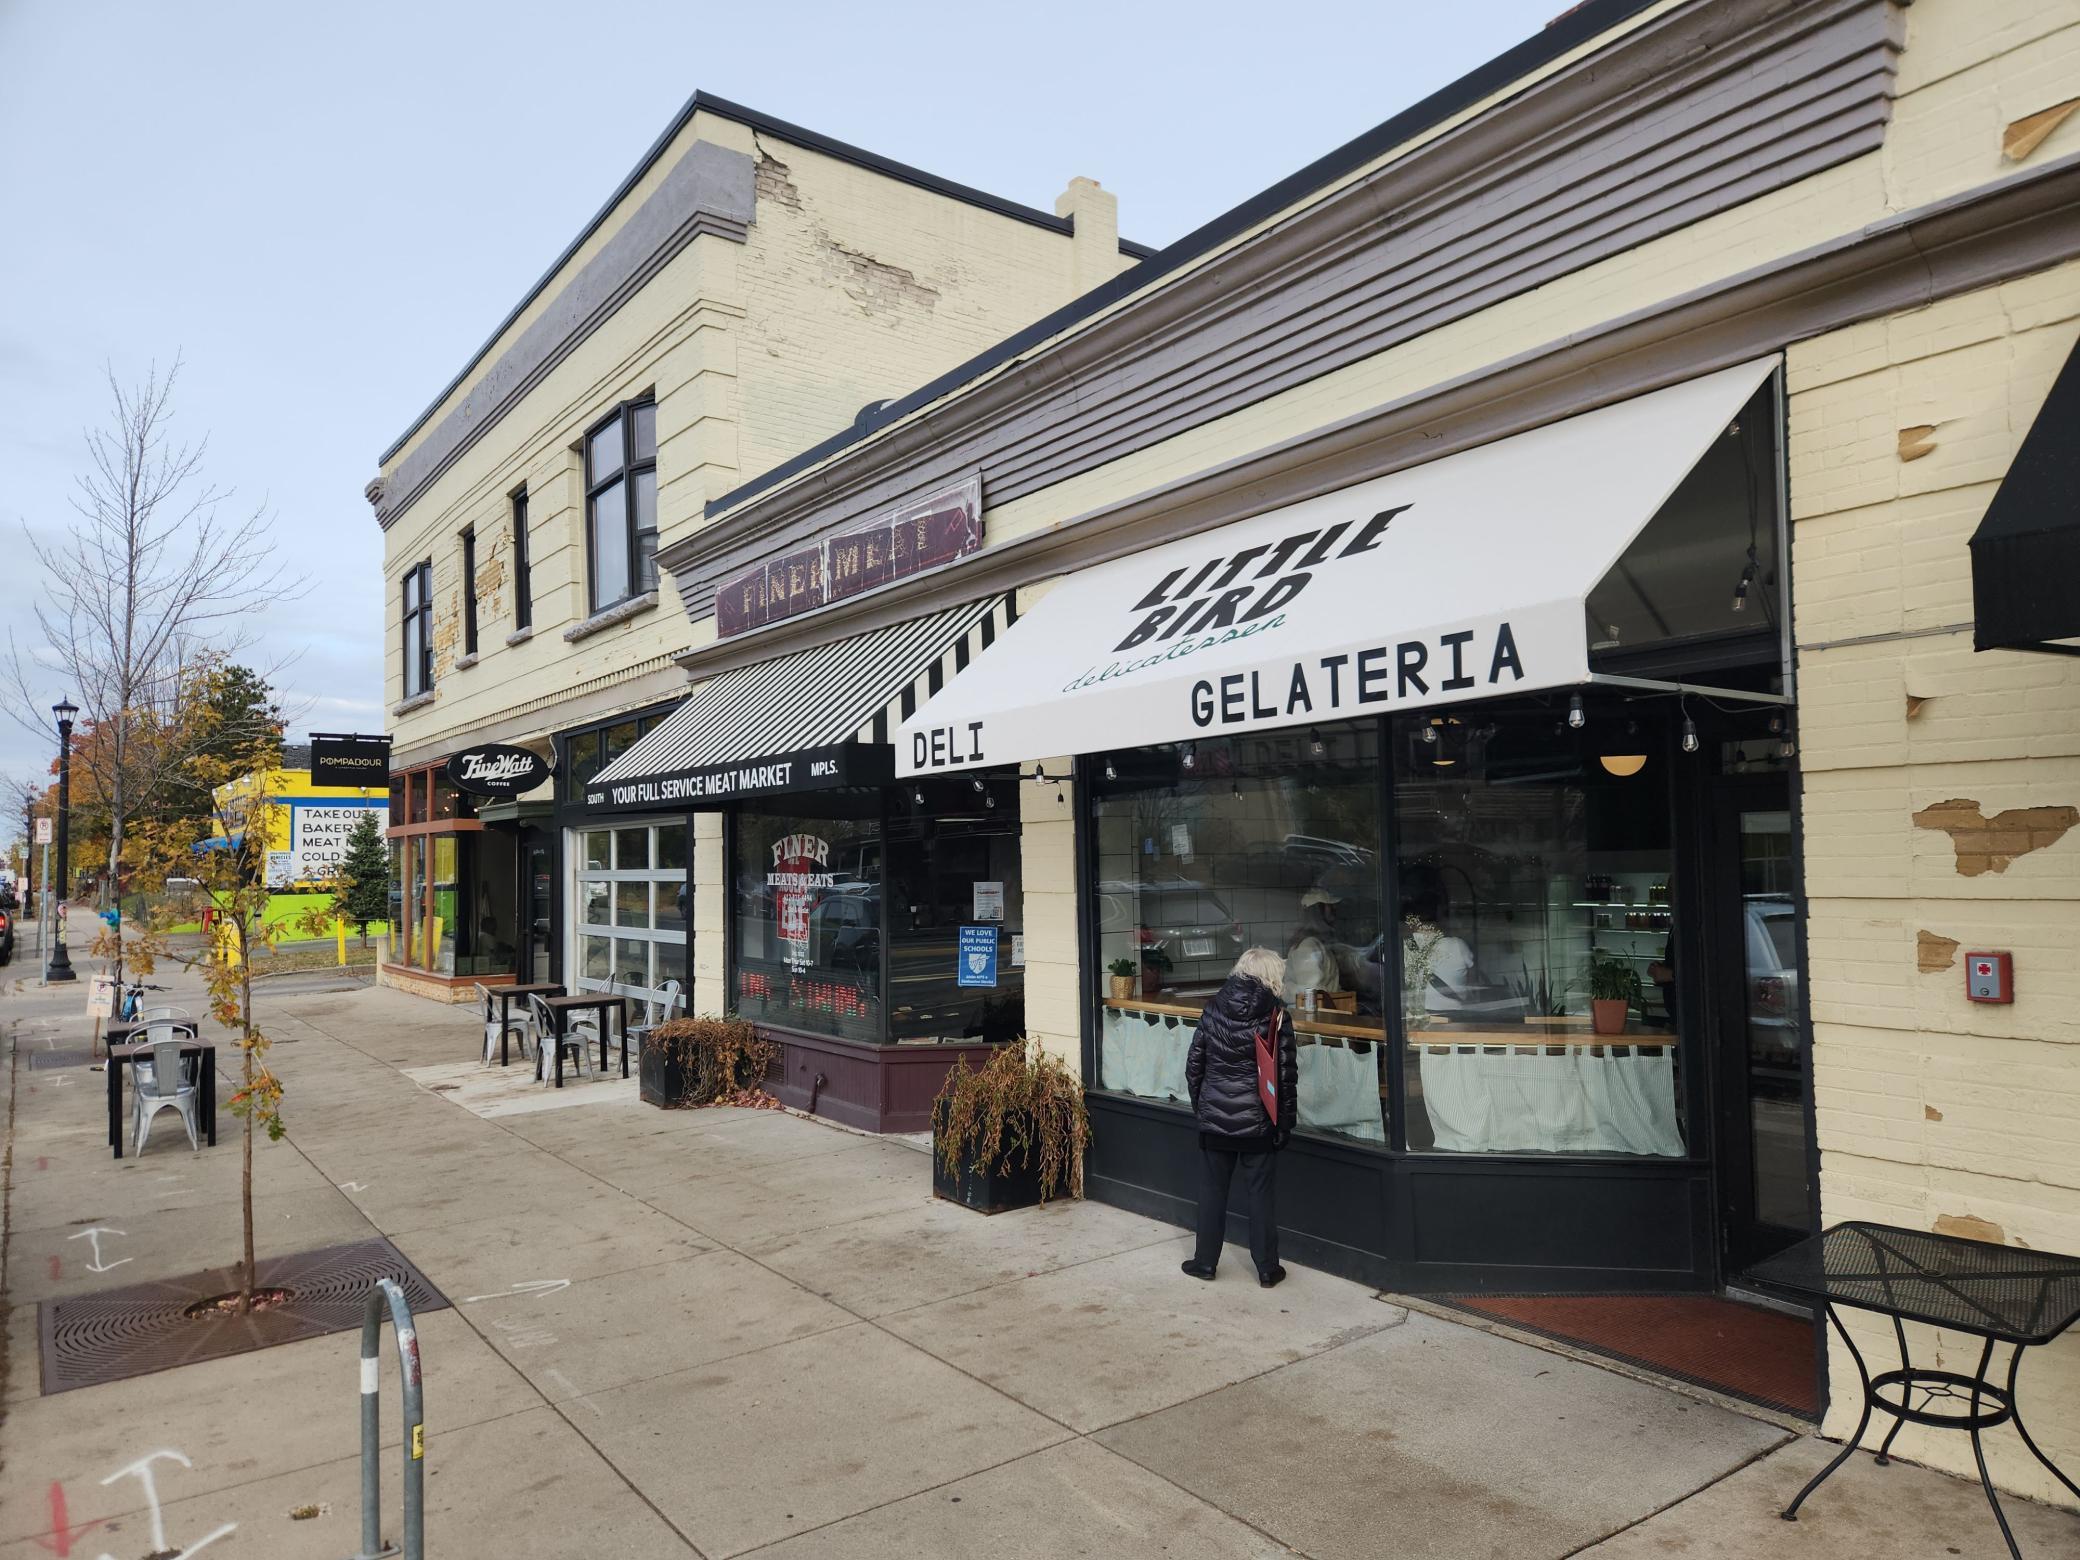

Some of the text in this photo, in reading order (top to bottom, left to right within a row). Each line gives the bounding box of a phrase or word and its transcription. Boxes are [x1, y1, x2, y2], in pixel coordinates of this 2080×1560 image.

[1129, 502, 1415, 612] LITTLE
[1111, 571, 1314, 653] BIRD
[1062, 613, 1287, 694] delicatessen
[1191, 622, 1525, 728] GELATERIA
[913, 720, 985, 770] DELI
[320, 757, 382, 767] POMPADOUR
[811, 760, 838, 777] MPLS.
[587, 763, 792, 805] SOUTH YOUR FULL SERVICE MEAT MARKET
[304, 810, 340, 819] TAKE
[302, 852, 340, 861] COLD
[303, 838, 341, 847] MEAT
[771, 834, 829, 867] FINER
[767, 873, 798, 887] MEATS
[807, 873, 834, 888] EATS
